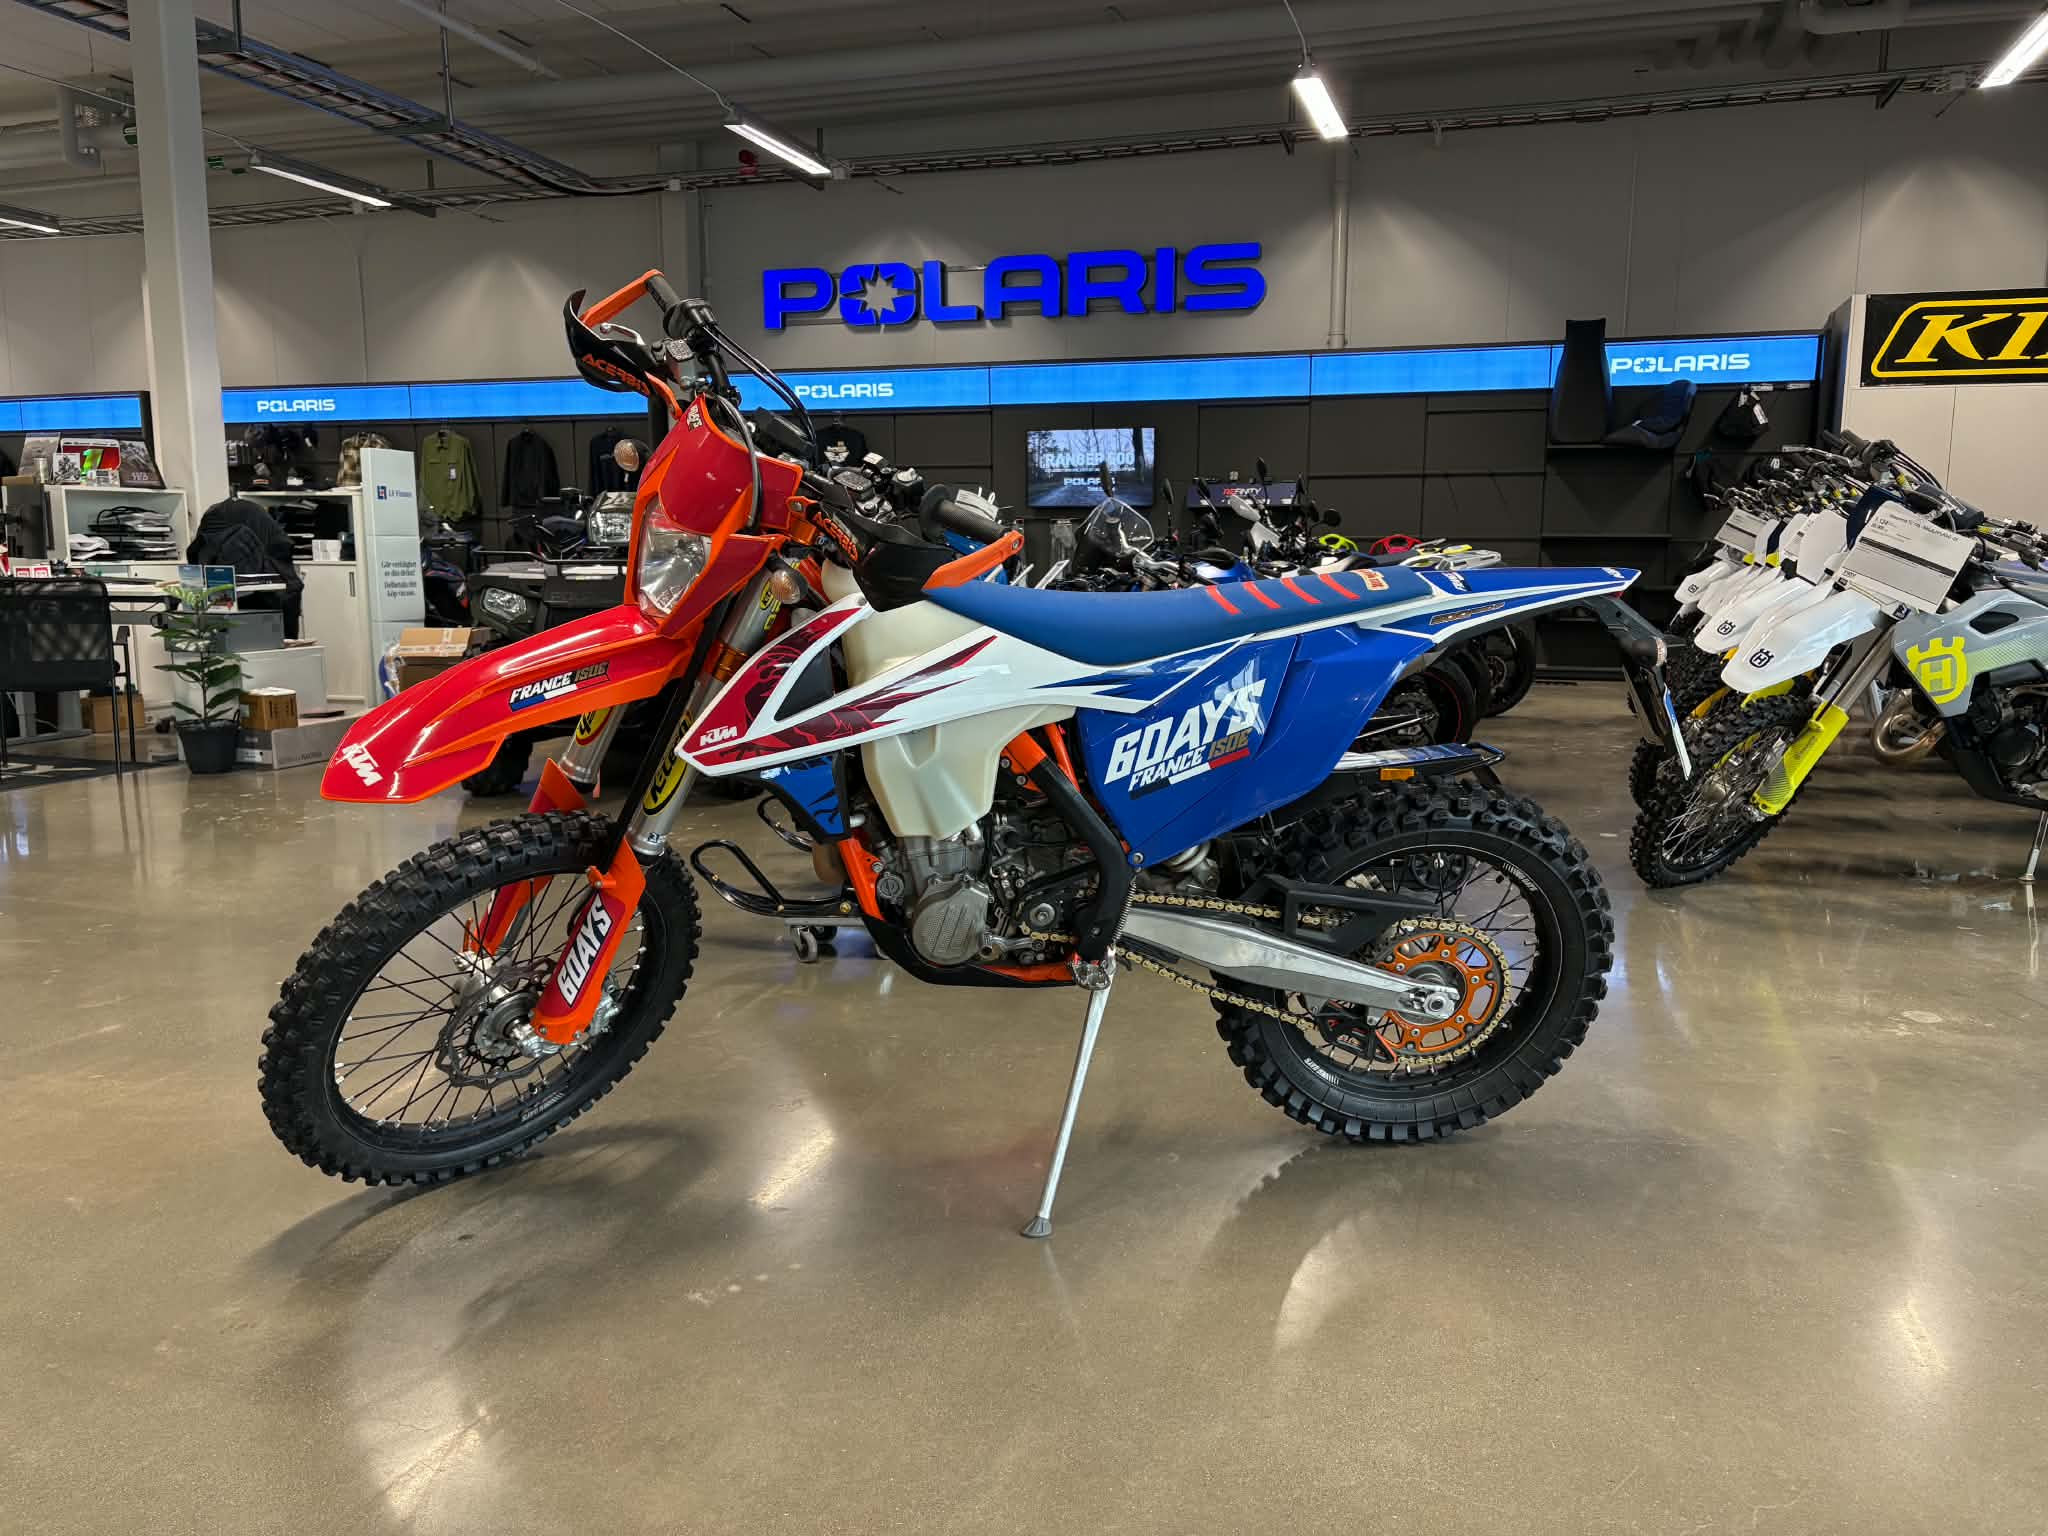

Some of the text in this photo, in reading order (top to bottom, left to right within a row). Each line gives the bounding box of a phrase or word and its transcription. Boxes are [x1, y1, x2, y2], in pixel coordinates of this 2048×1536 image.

[762, 242, 1267, 330] POLARIS
[1610, 353, 1751, 374] POLARIS
[794, 383, 894, 399] POLARIS
[256, 399, 336, 413] POLARIS
[1063, 477, 1116, 487] POLARS
[510, 671, 573, 703] FRANCE
[699, 725, 738, 746] KTM
[342, 743, 383, 786] KTM
[1128, 728, 1253, 792] FRANCE ISDE
